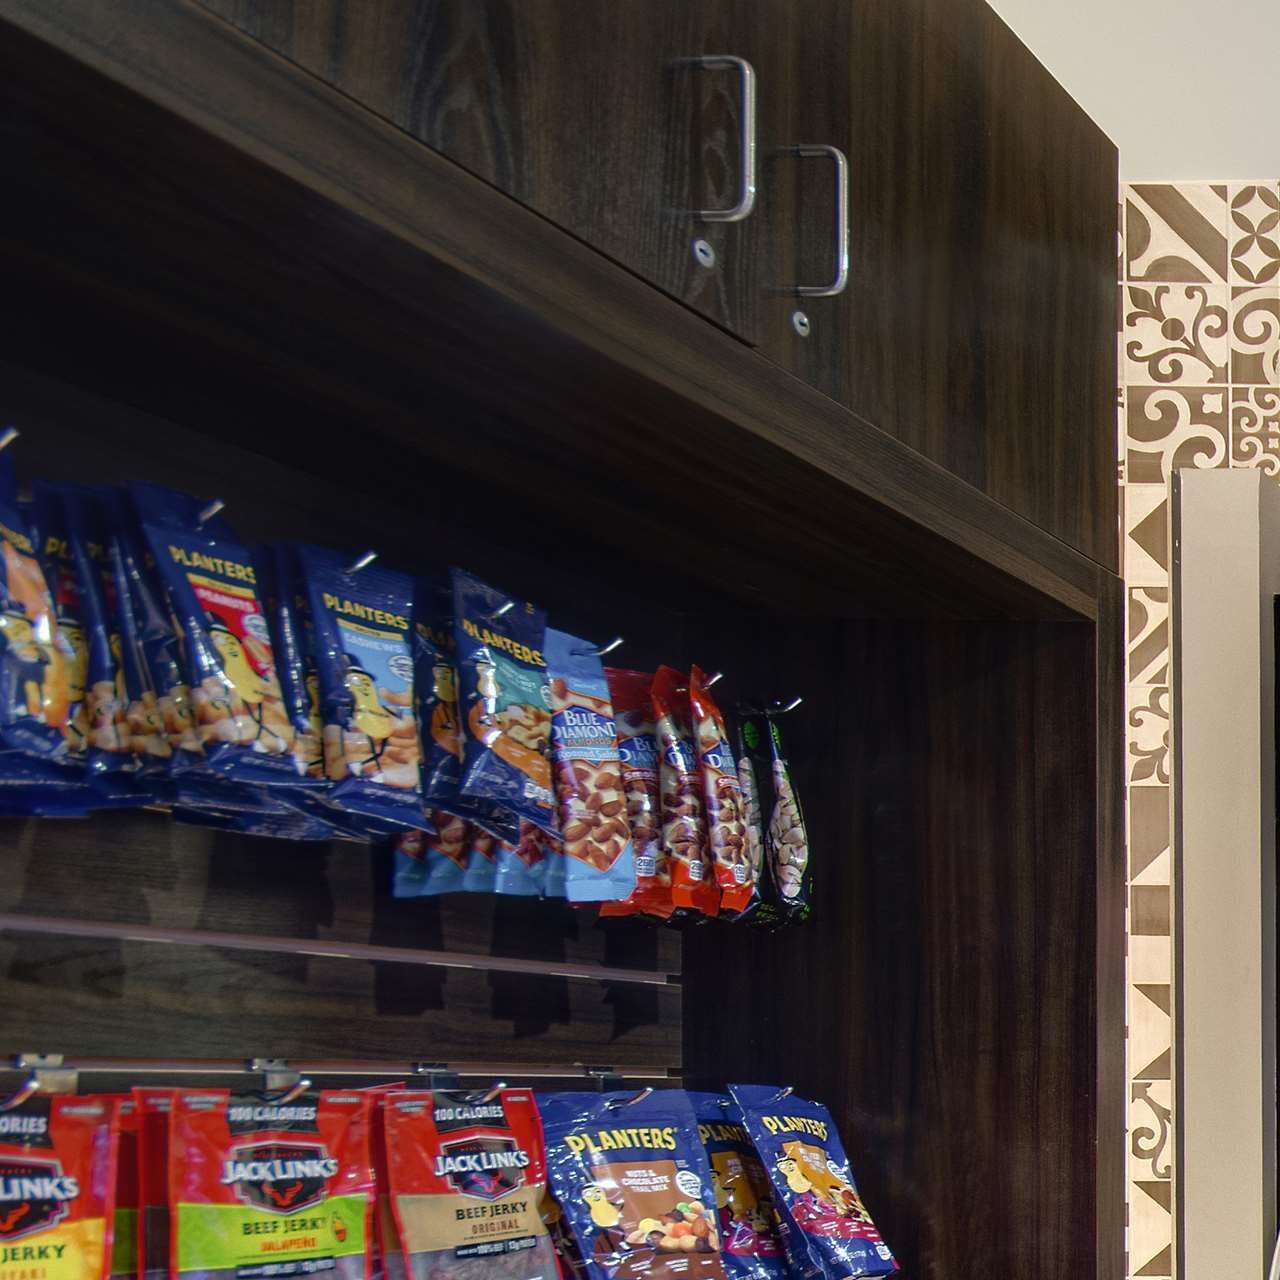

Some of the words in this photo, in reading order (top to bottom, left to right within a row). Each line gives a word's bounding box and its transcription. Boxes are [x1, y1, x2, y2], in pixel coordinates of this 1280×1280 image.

[168, 544, 257, 585] PLANTERS
[322, 592, 409, 631] PLANTERS
[463, 617, 546, 668] PLANTERS
[564, 710, 601, 727] BLUE
[552, 722, 617, 740] DIAMOND
[255, 1106, 318, 1122] CALORIES
[433, 1108, 455, 1121] 100
[455, 1105, 504, 1121] CALORIES
[0, 1116, 48, 1133] ORIES
[762, 1115, 829, 1143] PLANTERS
[563, 1126, 678, 1156] PLANTERS
[220, 1160, 276, 1185] JACK
[434, 1153, 482, 1176] JACK
[481, 1150, 530, 1170] LINK'S
[455, 1205, 488, 1221] BEEF
[489, 1201, 528, 1217] JERKY
[243, 1221, 281, 1236] BEEF
[471, 1218, 521, 1235] ORIGINAL
[1, 1244, 67, 1265] JERKY
